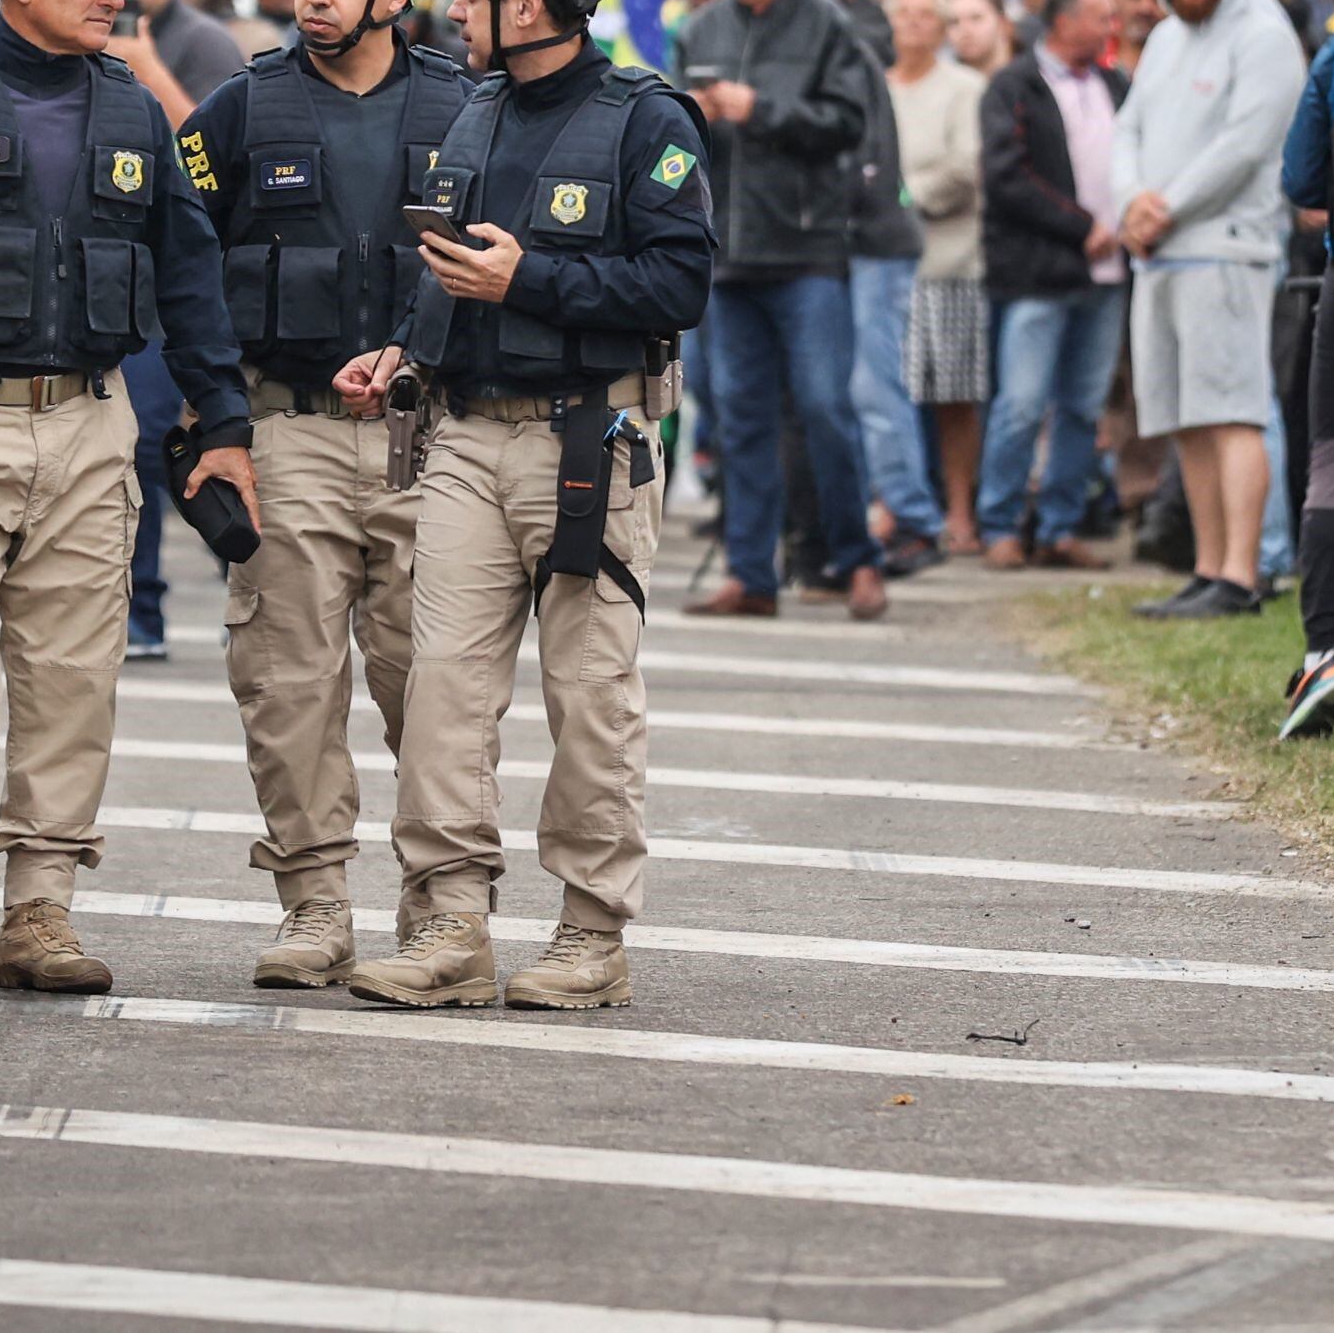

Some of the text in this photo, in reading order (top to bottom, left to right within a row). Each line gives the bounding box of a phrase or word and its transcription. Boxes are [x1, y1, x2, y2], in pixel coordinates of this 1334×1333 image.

[180, 130, 219, 191] PRF
[274, 166, 297, 176] PRF
[275, 175, 305, 185] SANTIAGO
